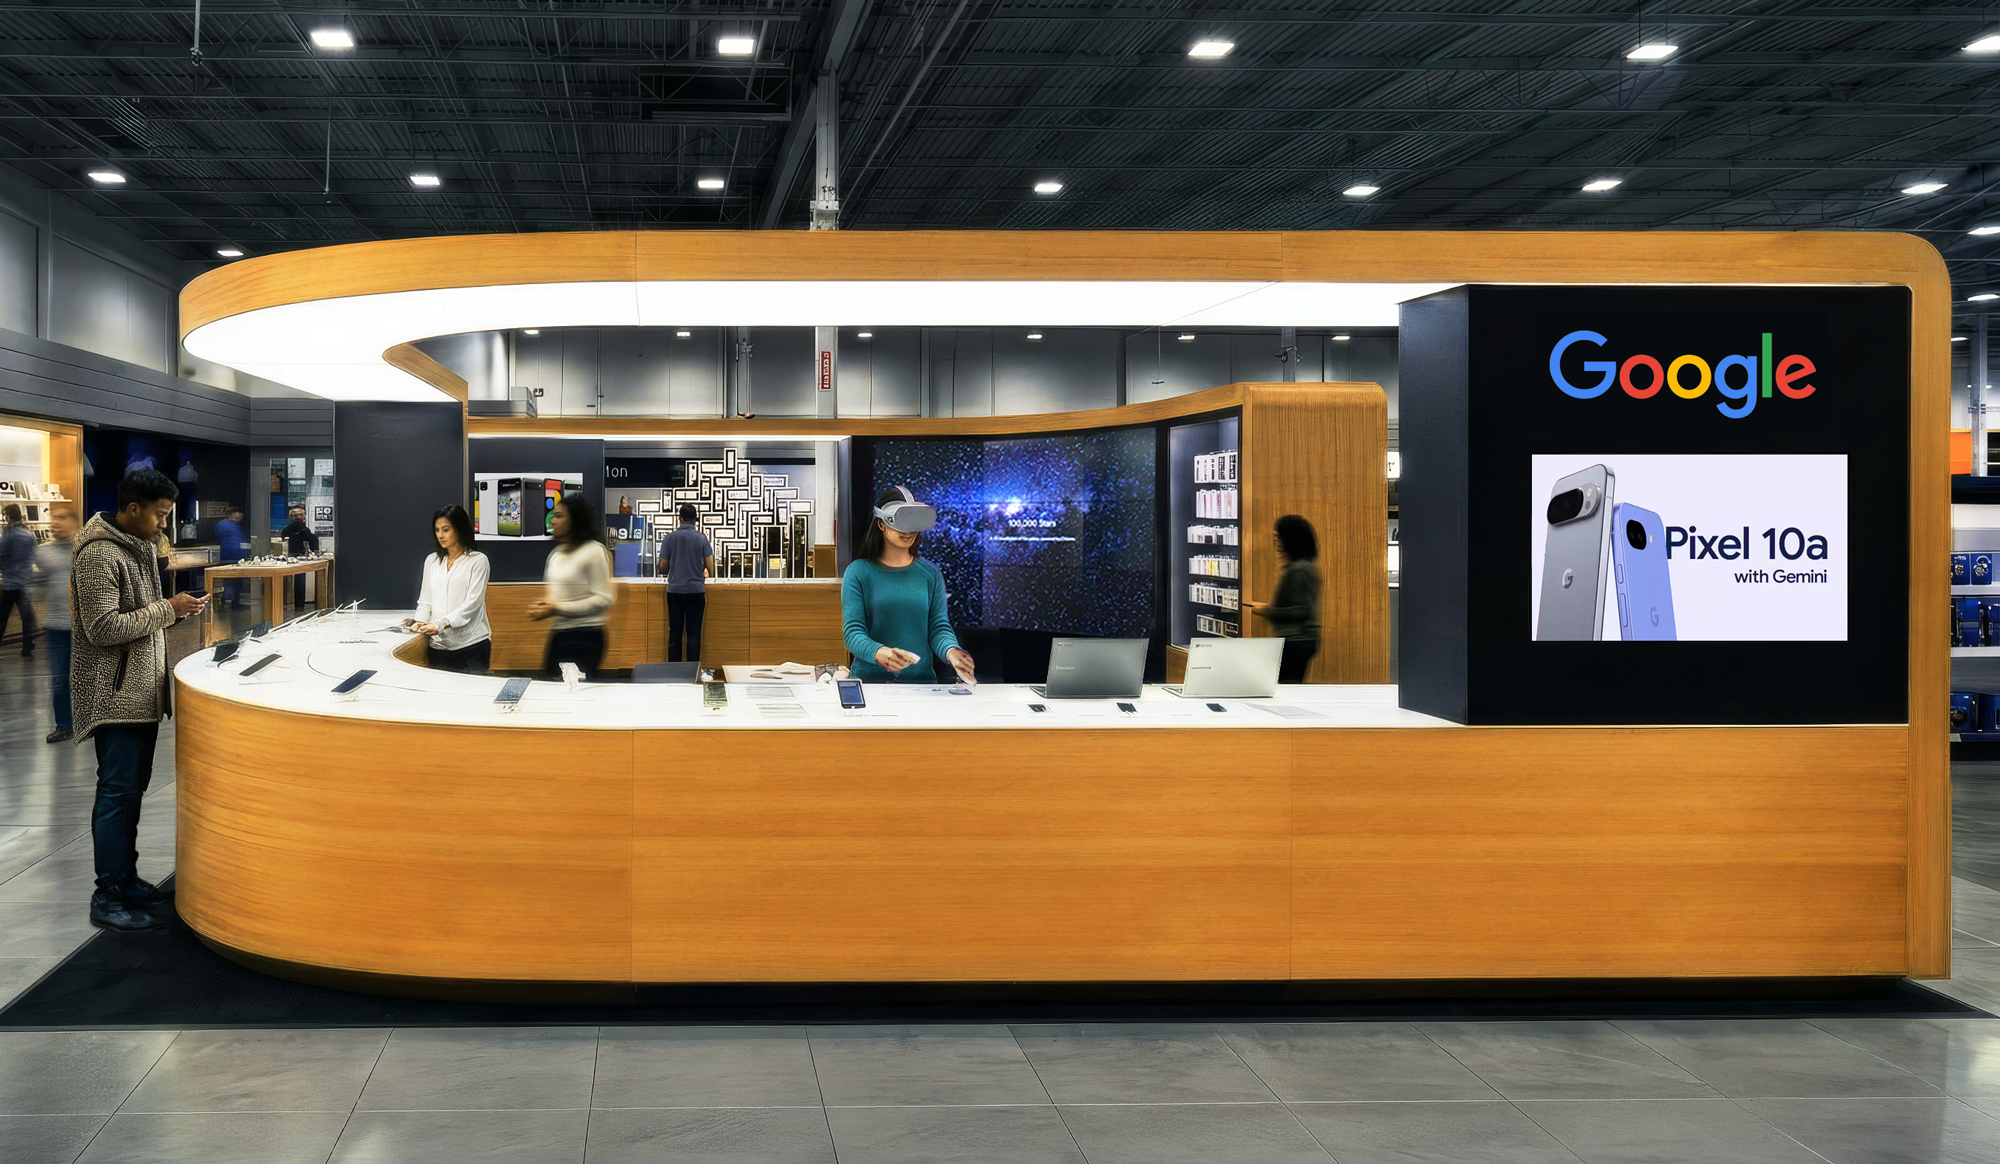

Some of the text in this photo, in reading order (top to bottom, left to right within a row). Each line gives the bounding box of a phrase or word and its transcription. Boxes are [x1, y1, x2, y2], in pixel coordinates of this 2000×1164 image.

[1549, 330, 1817, 419] Google
[1039, 518, 1057, 528] Stars
[1665, 526, 1828, 560] Pixel 10a
[1734, 568, 1828, 584] with Gemini
